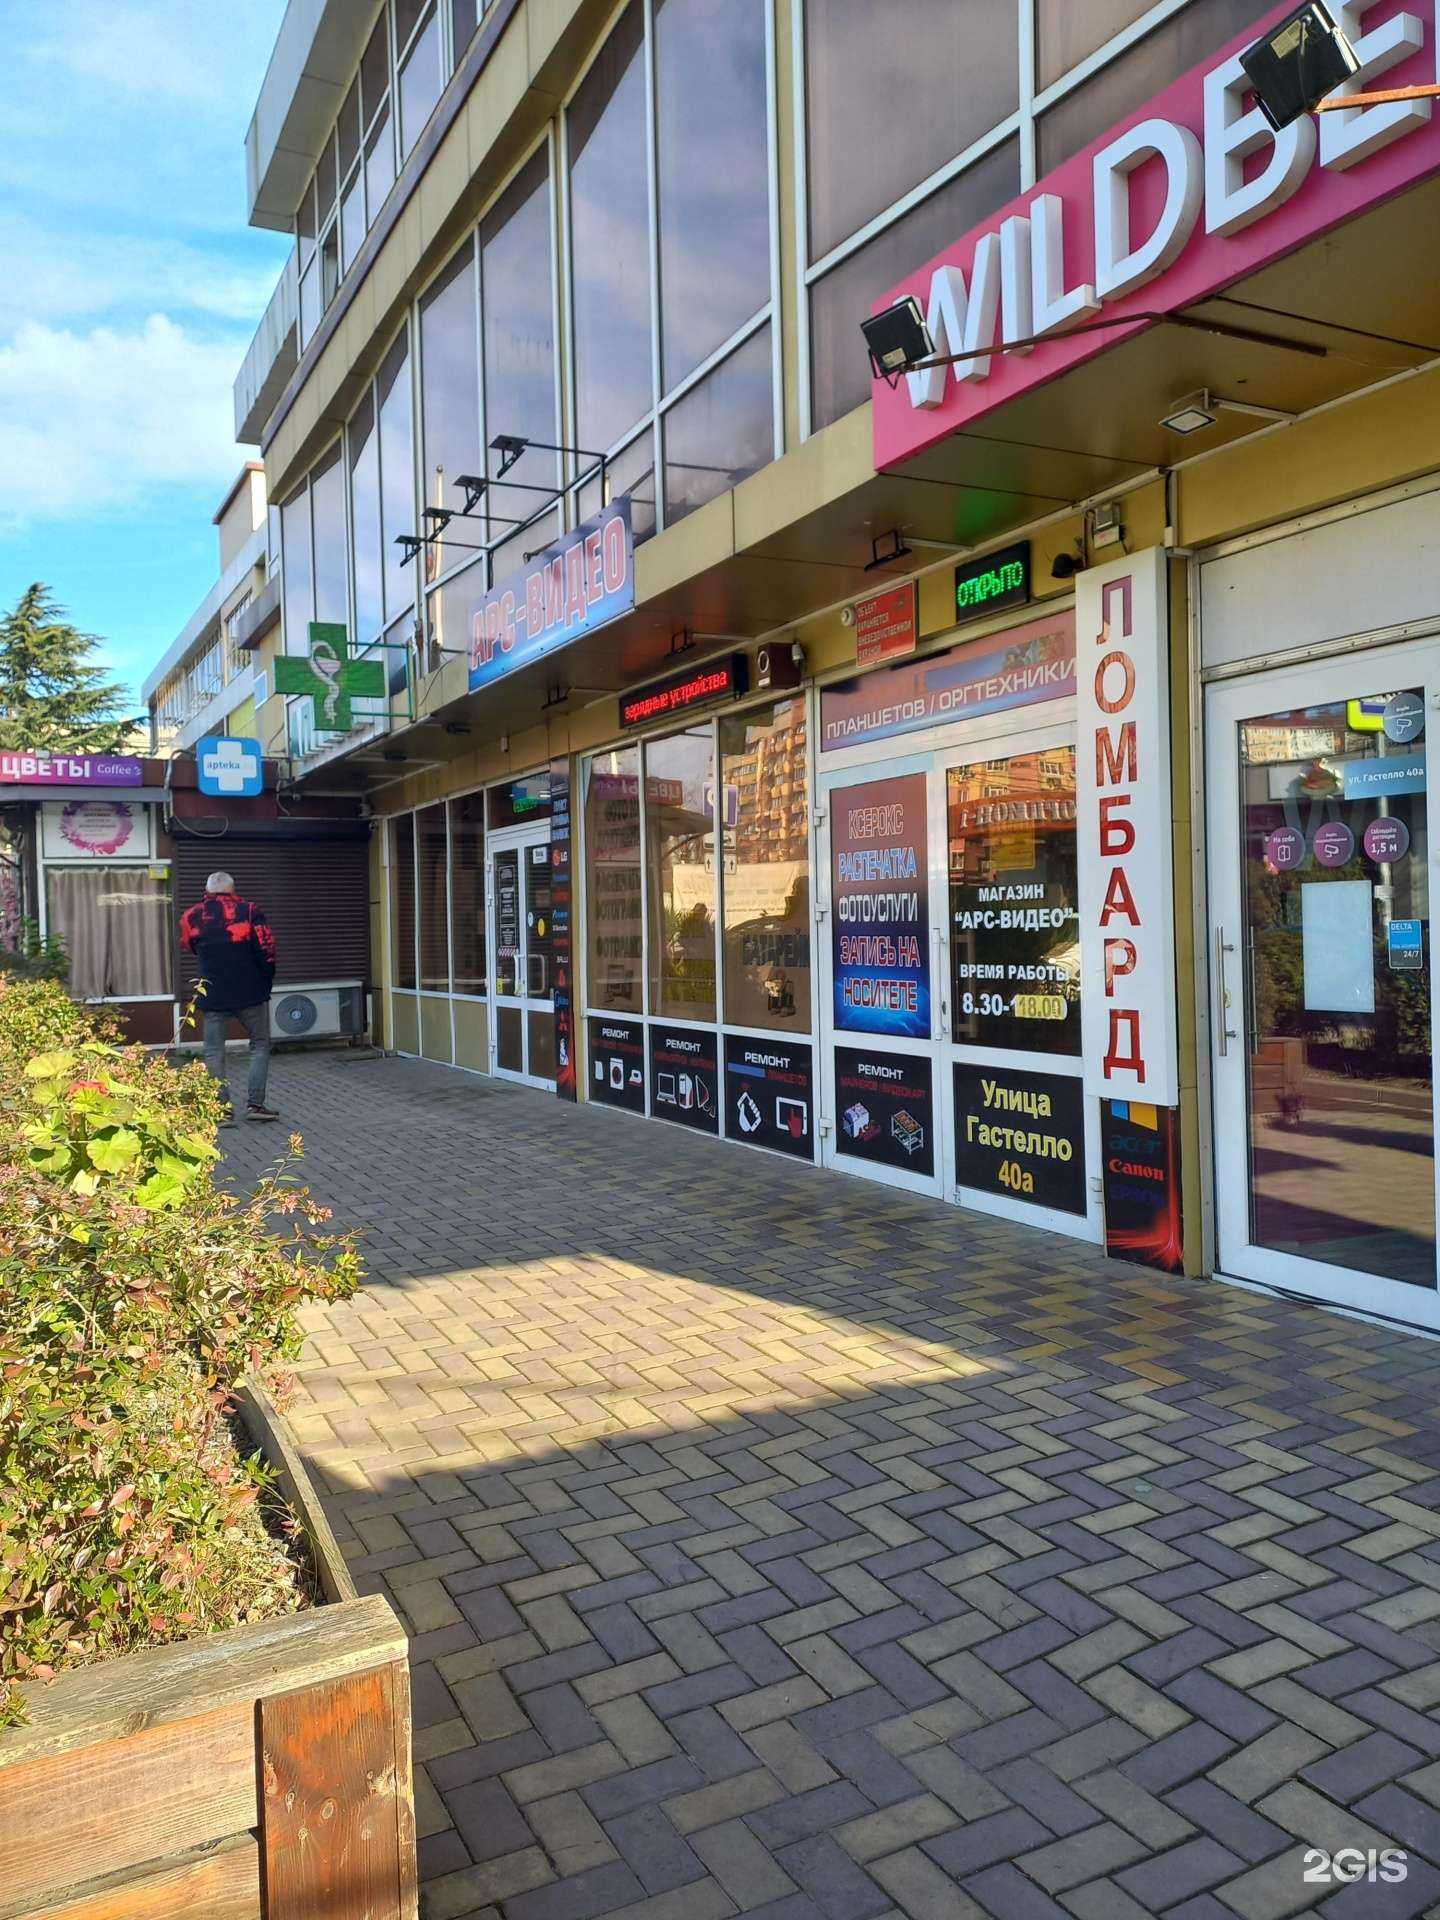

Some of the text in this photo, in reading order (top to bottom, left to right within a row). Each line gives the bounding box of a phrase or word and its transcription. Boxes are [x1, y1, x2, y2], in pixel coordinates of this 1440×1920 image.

[893, 0, 1440, 409] WILDBE
[471, 516, 626, 671] АРС-ВИДЕО
[957, 561, 1023, 608] ОТКРЫТО
[826, 699, 924, 739] ПЛАНШЕТОВ
[939, 657, 1077, 711] ОРГТЕХНИКИ
[2, 757, 132, 779] ЦВЕТЫ Coffee
[207, 761, 240, 770] apteka
[1363, 770, 1405, 783] Гастелло
[1406, 766, 1424, 777] 40а
[848, 803, 904, 839] КСЕРОКС
[1094, 574, 1146, 1084] ЛОМБАРД
[561, 851, 568, 862] LG
[1371, 842, 1387, 855] 1,5
[838, 847, 917, 882] РАСПЕЧАТКА
[978, 884, 1044, 902] МАГАЗИН
[839, 892, 918, 922] ФОТОУСЛУГИ
[1391, 922, 1412, 931] DELTA
[840, 936, 921, 967] ЗАПИСЬ НА
[1403, 951, 1419, 959] 24/7
[960, 964, 1070, 981] ВРЕМЯ РАБОТЫ
[844, 977, 918, 1012] НОСИТЕЛЕ
[602, 1027, 630, 1040] РЕМОНТ
[665, 1038, 701, 1053] РЕМОНТ
[744, 1051, 790, 1069] РЕМОНТ
[858, 1063, 904, 1081] РЕМОНТ
[981, 1079, 1051, 1119] Улица
[966, 1115, 1073, 1161] Гастелло
[998, 1160, 1034, 1193] 40а
[1108, 1158, 1164, 1181] Canon
